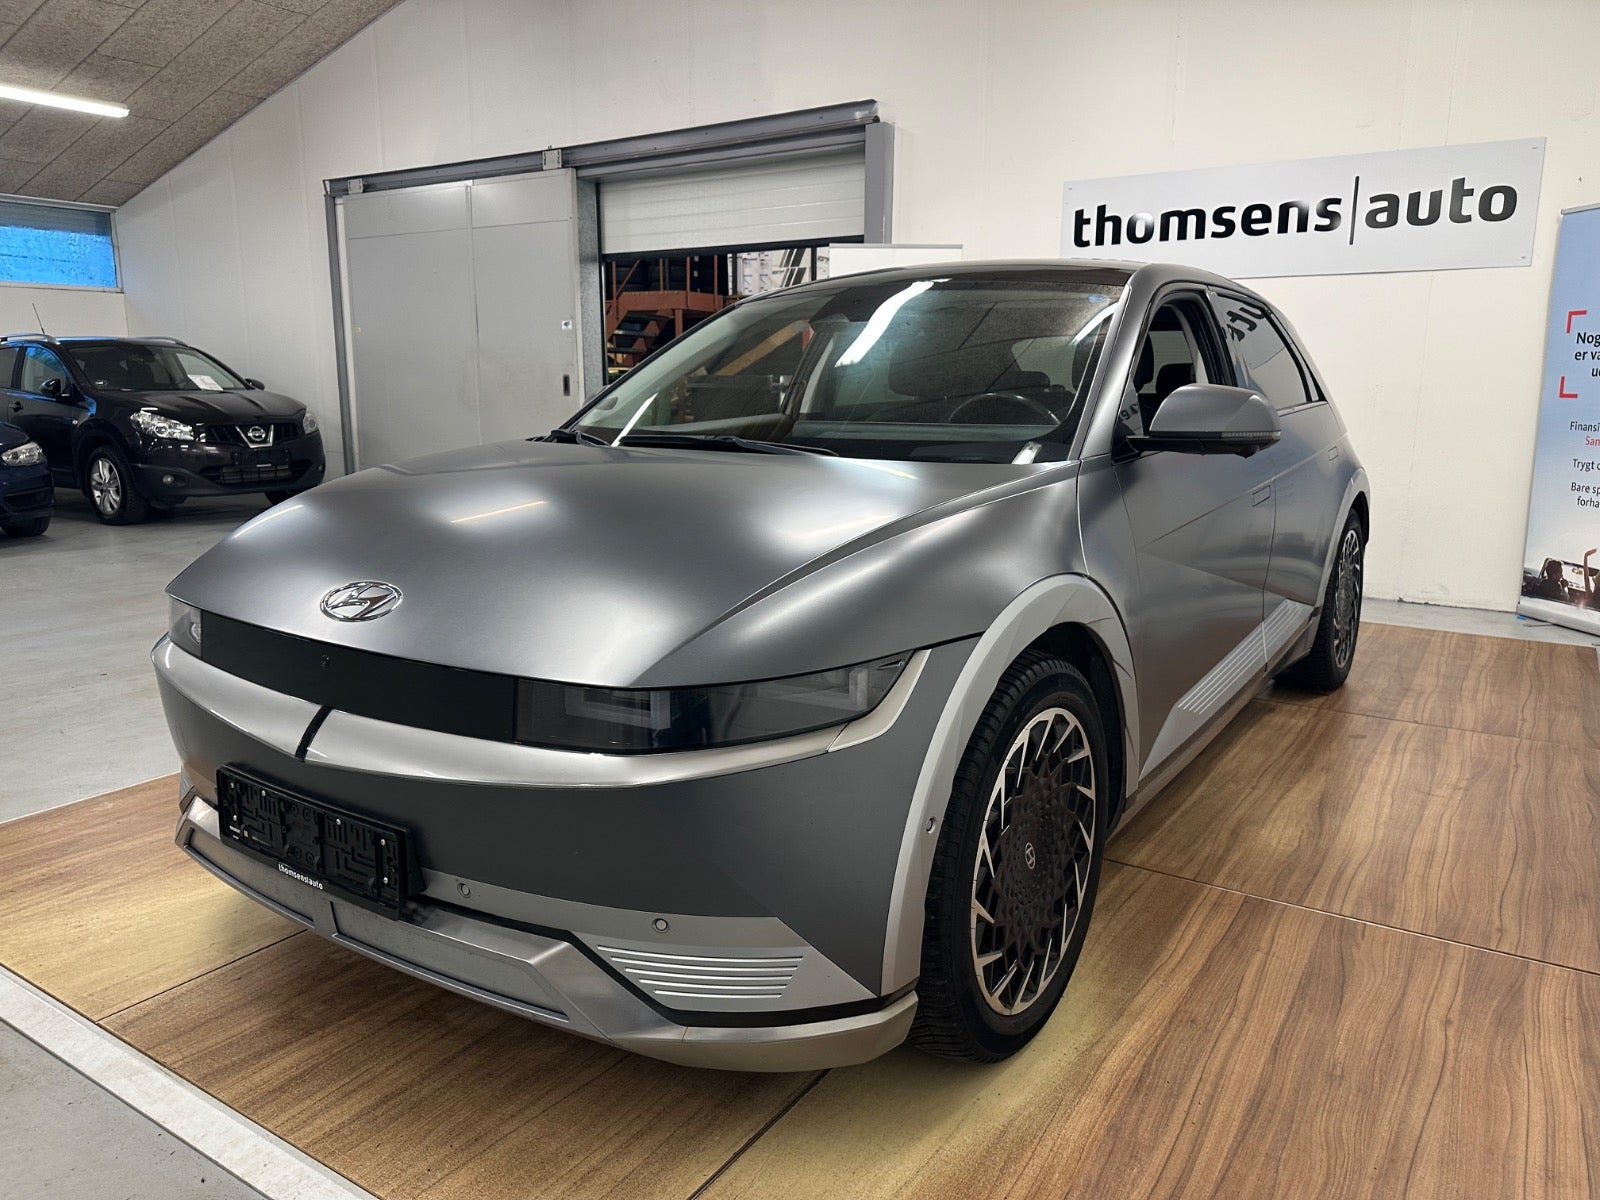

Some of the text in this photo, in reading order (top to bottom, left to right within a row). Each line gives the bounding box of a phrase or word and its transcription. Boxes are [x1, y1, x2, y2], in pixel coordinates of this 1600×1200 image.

[1574, 351, 1588, 361] er
[1573, 458, 1594, 472] Trygt
[1571, 481, 1590, 494] Bare
